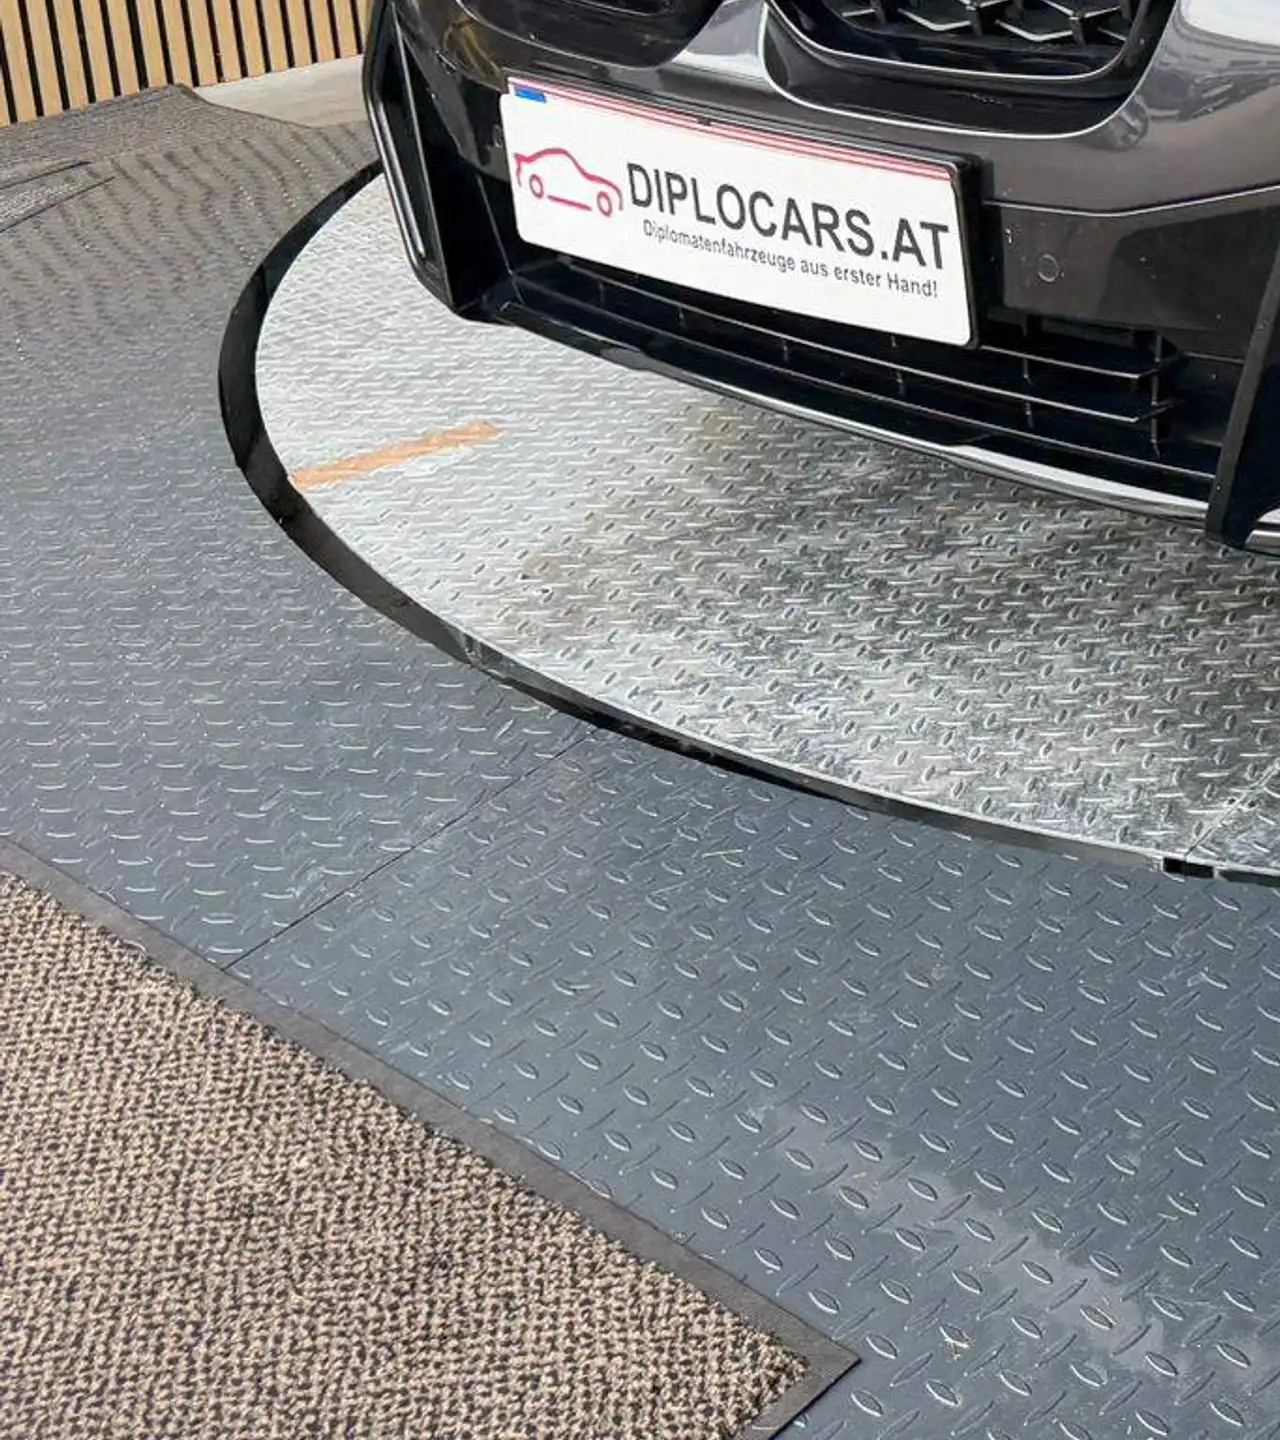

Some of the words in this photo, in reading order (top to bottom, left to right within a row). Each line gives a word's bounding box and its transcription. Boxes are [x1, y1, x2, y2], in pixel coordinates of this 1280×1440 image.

[627, 162, 949, 270] DIPLOCARS.AT
[643, 219, 796, 273] Diplomatenfahrzeuge
[800, 259, 829, 278] aus
[833, 266, 882, 288] erster
[886, 271, 938, 298] Hand!
